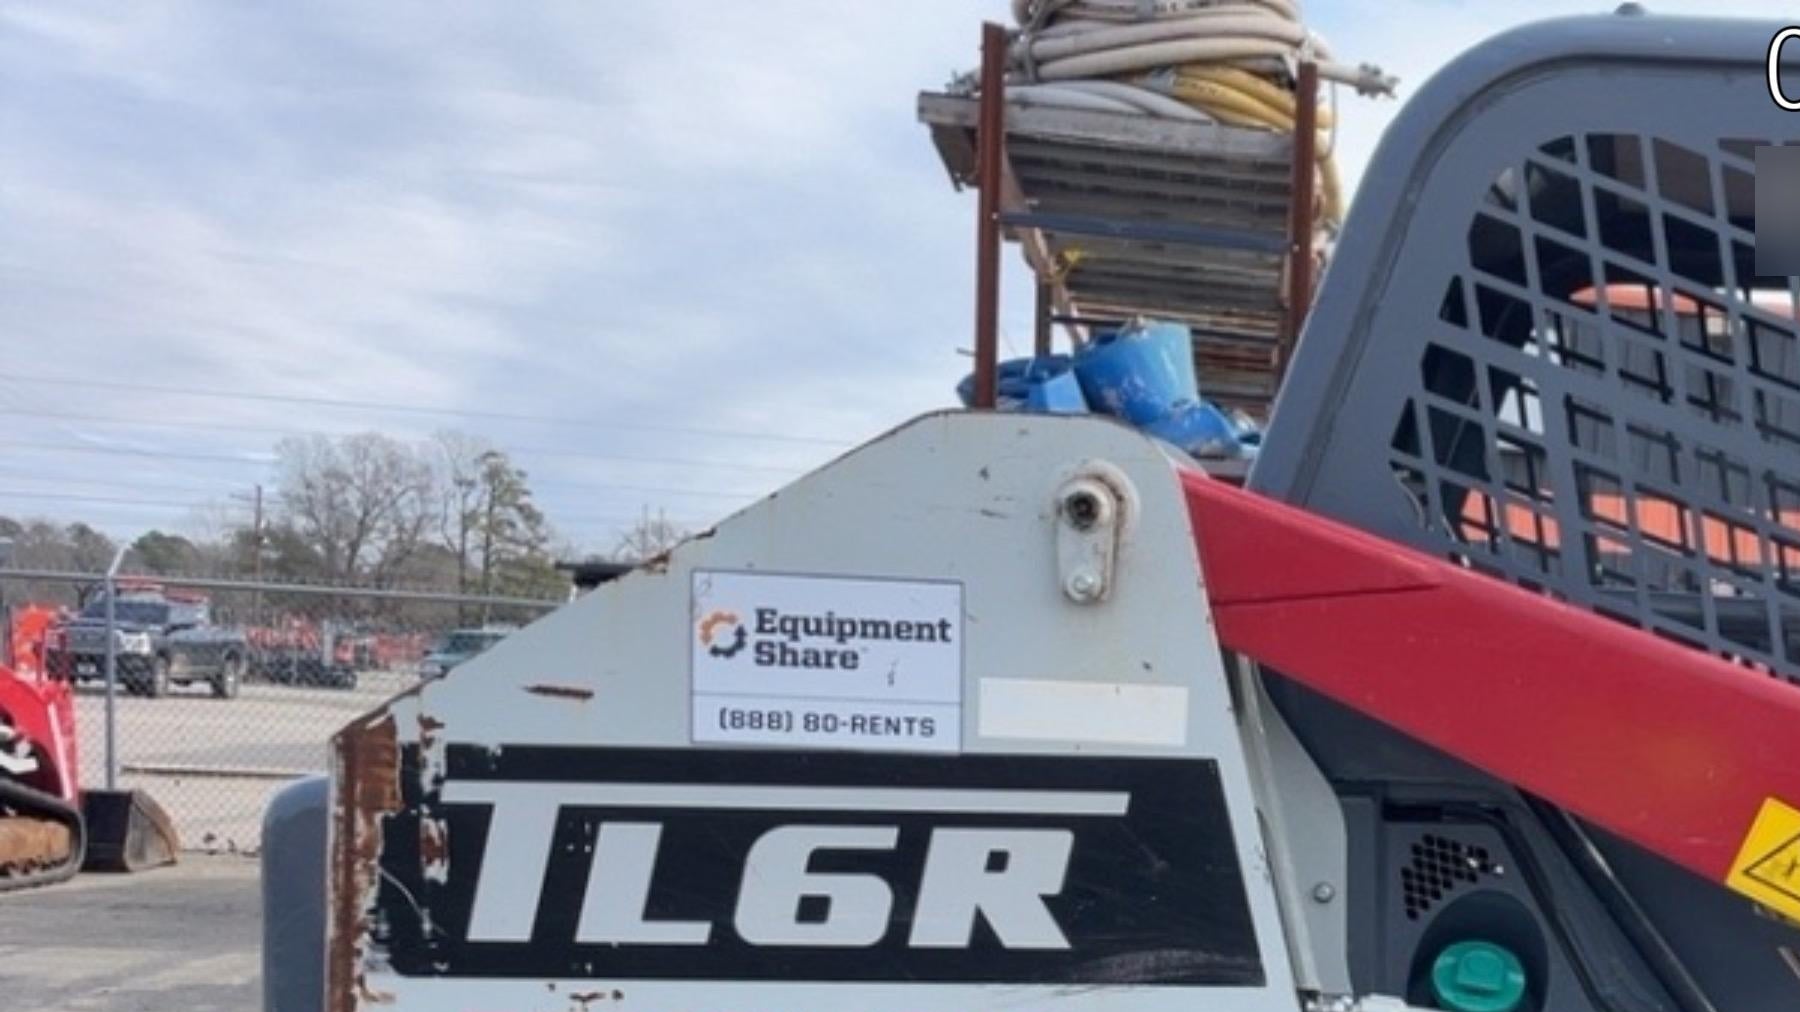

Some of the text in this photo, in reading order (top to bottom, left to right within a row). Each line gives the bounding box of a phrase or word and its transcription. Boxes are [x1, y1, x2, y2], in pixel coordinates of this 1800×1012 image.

[754, 607, 953, 643] Equipment
[754, 640, 860, 670] Share
[718, 706, 936, 738] (888) 80-RENTS
[441, 779, 1132, 951] TL6R
